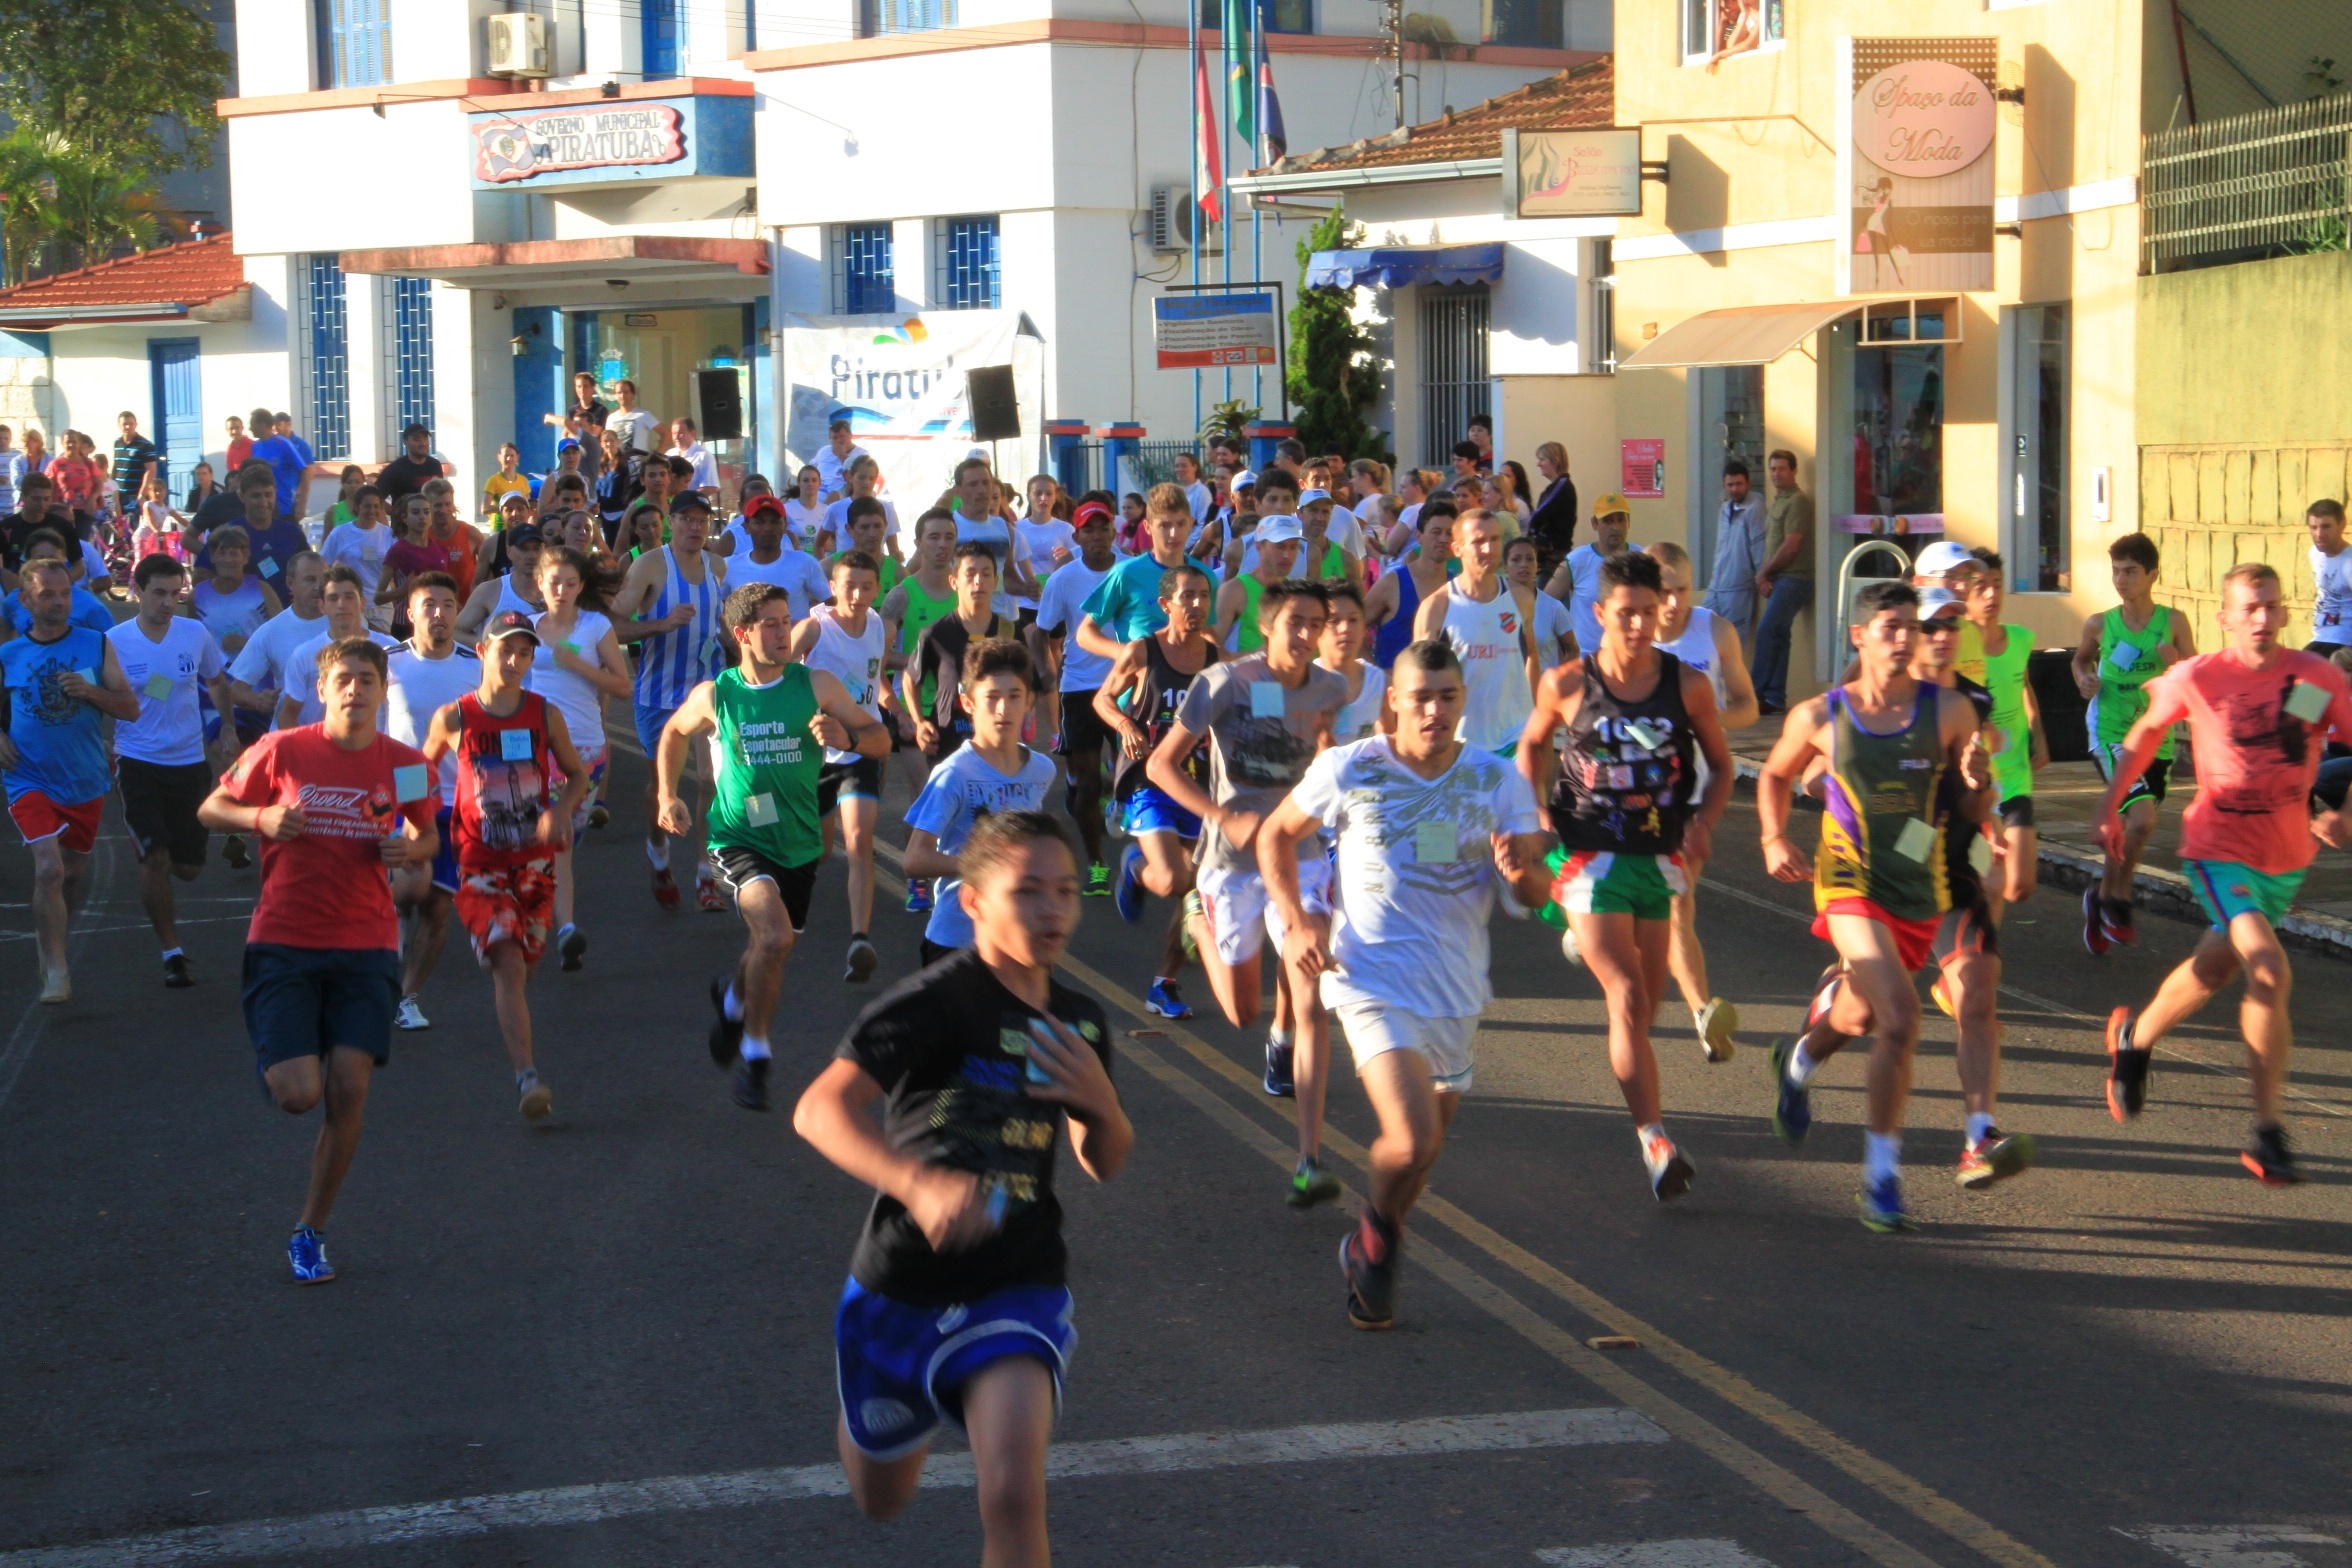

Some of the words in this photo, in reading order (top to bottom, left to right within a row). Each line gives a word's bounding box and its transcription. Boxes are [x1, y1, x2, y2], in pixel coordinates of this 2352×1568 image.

[1872, 75, 1945, 119] Spaço
[1949, 81, 1979, 107] da
[536, 116, 585, 136] GOVERNO
[595, 111, 660, 132] MUNICIPAL
[1885, 126, 1963, 162] Moda
[740, 721, 785, 736] Esporte
[744, 751, 803, 766] 3444-0100
[297, 783, 363, 809] Proerd
